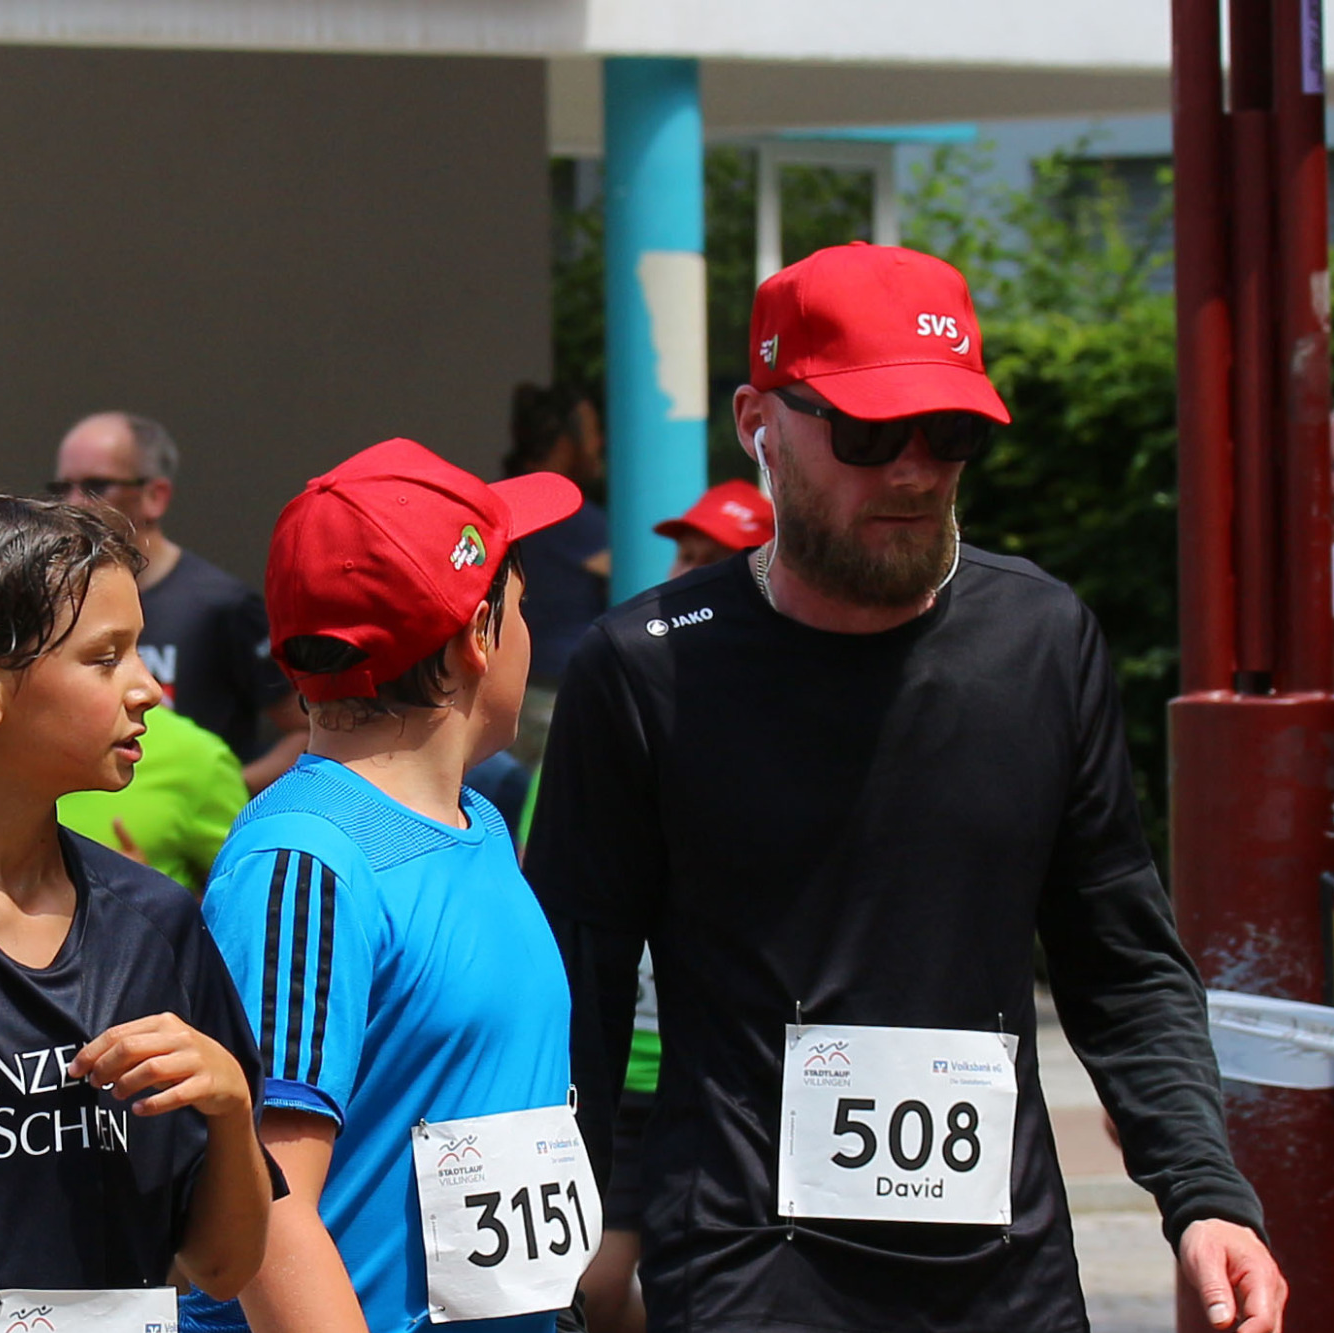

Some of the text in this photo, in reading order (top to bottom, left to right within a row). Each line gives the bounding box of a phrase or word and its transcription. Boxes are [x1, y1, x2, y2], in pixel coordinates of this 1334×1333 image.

[917, 313, 958, 339] SVS
[670, 607, 714, 629] JAKO
[803, 1069, 851, 1078] STADTLAUF
[803, 1077, 851, 1088] VILLINGEN
[831, 1097, 982, 1173] 508
[438, 1165, 483, 1178] STADTLAUF
[439, 1174, 485, 1187] VILLINGEN
[876, 1177, 944, 1199] David
[464, 1180, 590, 1268] 3151
